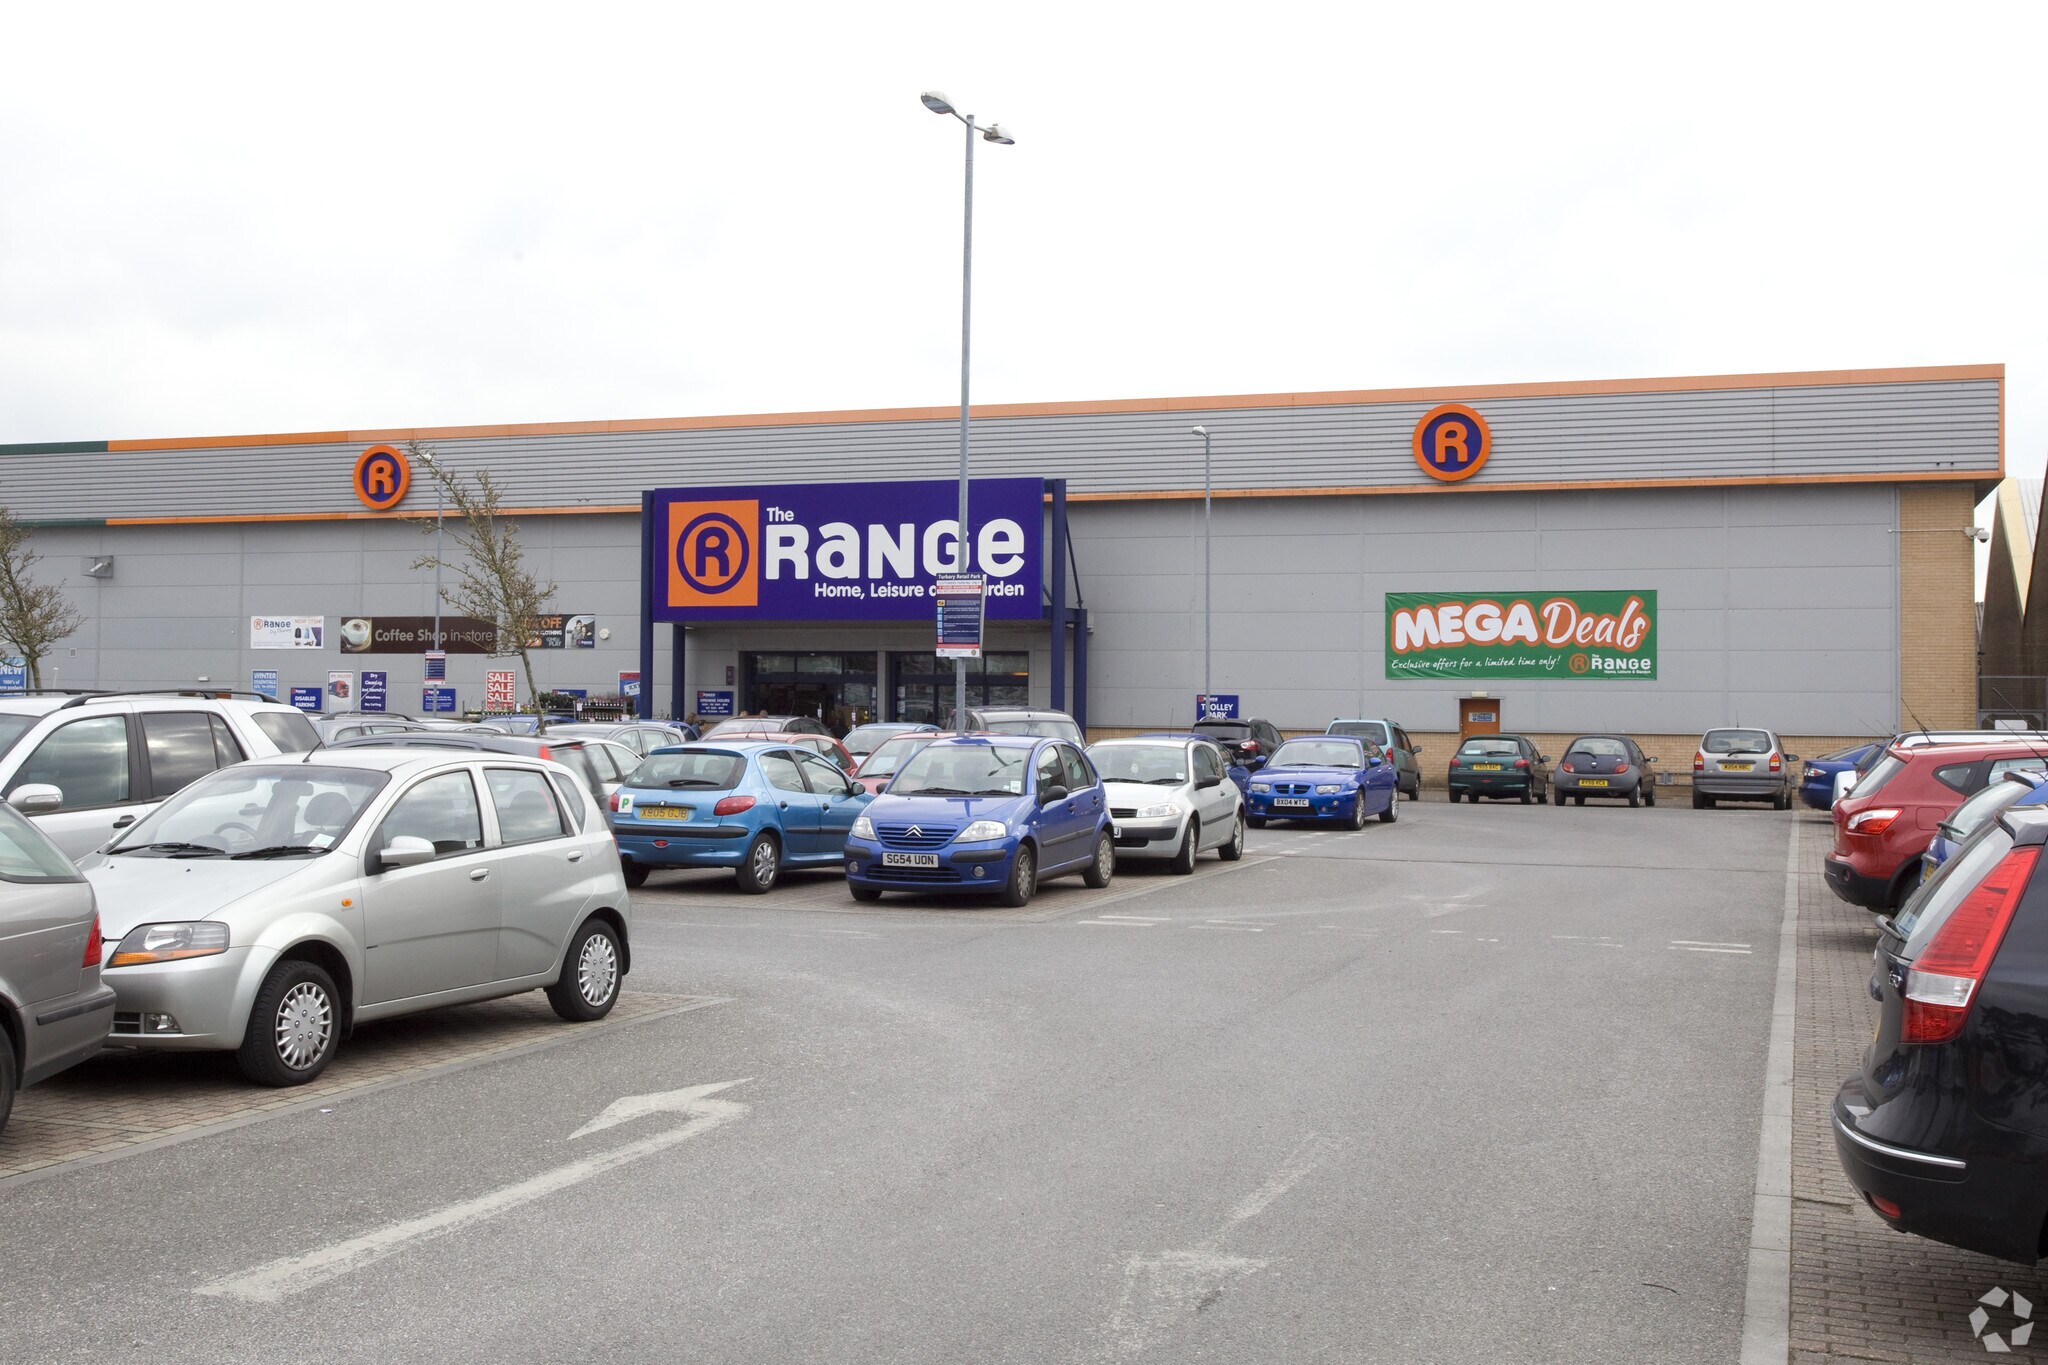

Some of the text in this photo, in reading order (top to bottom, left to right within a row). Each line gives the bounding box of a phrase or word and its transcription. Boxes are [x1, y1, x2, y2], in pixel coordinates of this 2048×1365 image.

[766, 506, 795, 522] The
[815, 582, 866, 600] Home,
[870, 581, 925, 598] Leisure
[1395, 599, 1647, 650] MEGA Deals
[375, 628, 414, 642] Coffee
[1391, 658, 1431, 669] Exclusive
[1432, 657, 1457, 671] offers
[1459, 656, 1473, 671] for
[1484, 656, 1516, 667] limited
[1518, 656, 1536, 666] time
[1538, 654, 1562, 671] only!
[488, 672, 514, 682] SALE
[488, 683, 514, 692] SALE
[488, 693, 514, 702] SALE
[622, 798, 630, 809] P
[641, 808, 666, 818] X905
[886, 854, 934, 866] SG54 UON
